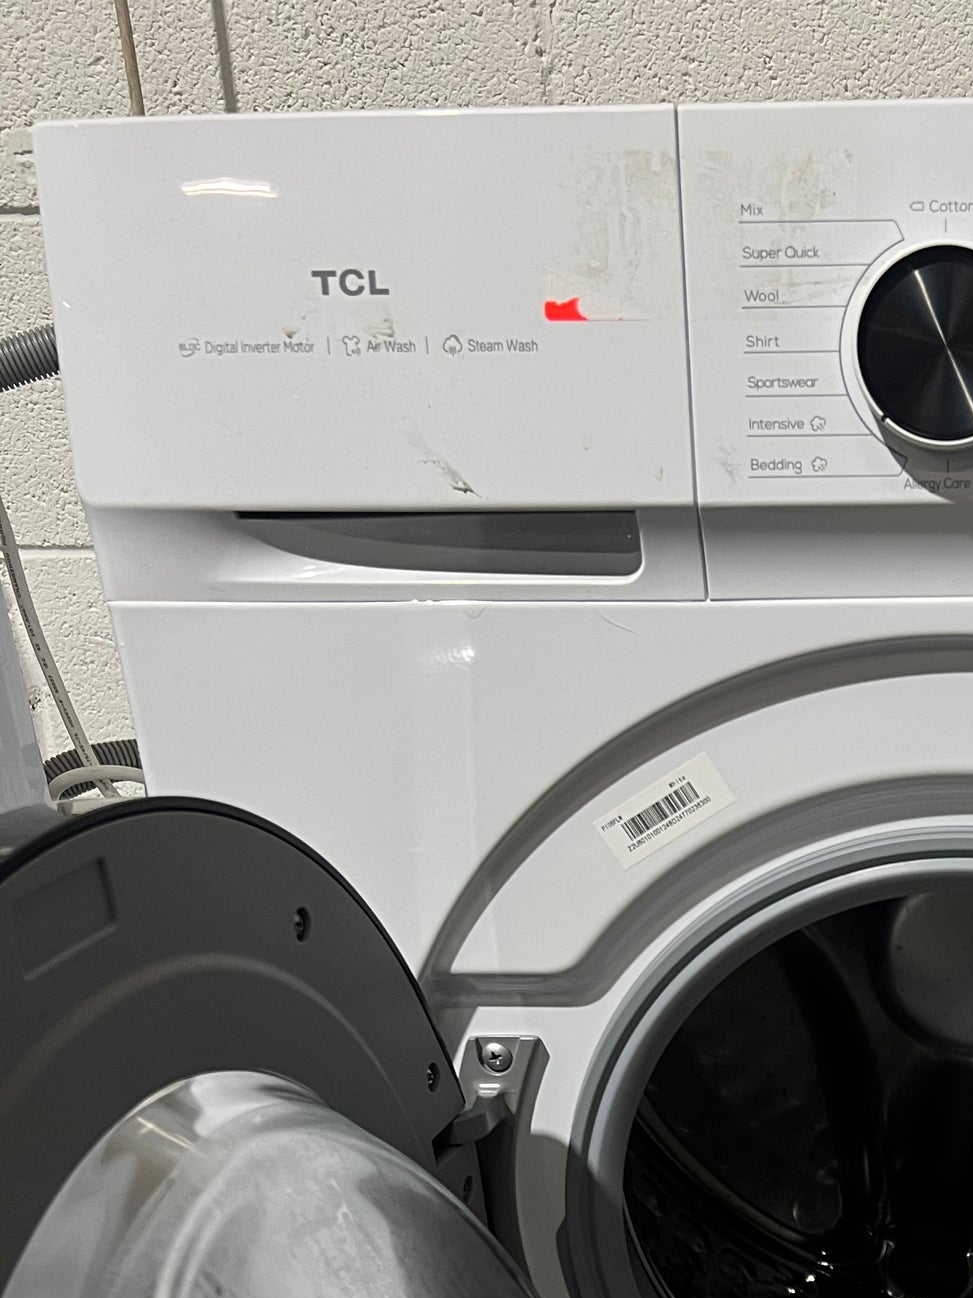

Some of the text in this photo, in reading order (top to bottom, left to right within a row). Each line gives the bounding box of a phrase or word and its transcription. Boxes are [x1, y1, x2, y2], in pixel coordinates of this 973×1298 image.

[740, 203, 764, 216] Mix
[742, 245, 819, 262] Super Quick
[311, 268, 390, 296] TCL
[744, 289, 779, 302] Wool
[205, 340, 315, 356] Digital Inverter Motor
[367, 339, 416, 353] Air Wash
[467, 339, 539, 353] Steam Wash
[745, 335, 780, 348] Shirt
[747, 376, 819, 391] Sportswear
[749, 417, 805, 431] Intensive
[750, 458, 803, 474] Bedding
[904, 477, 971, 492] Allergy Care
